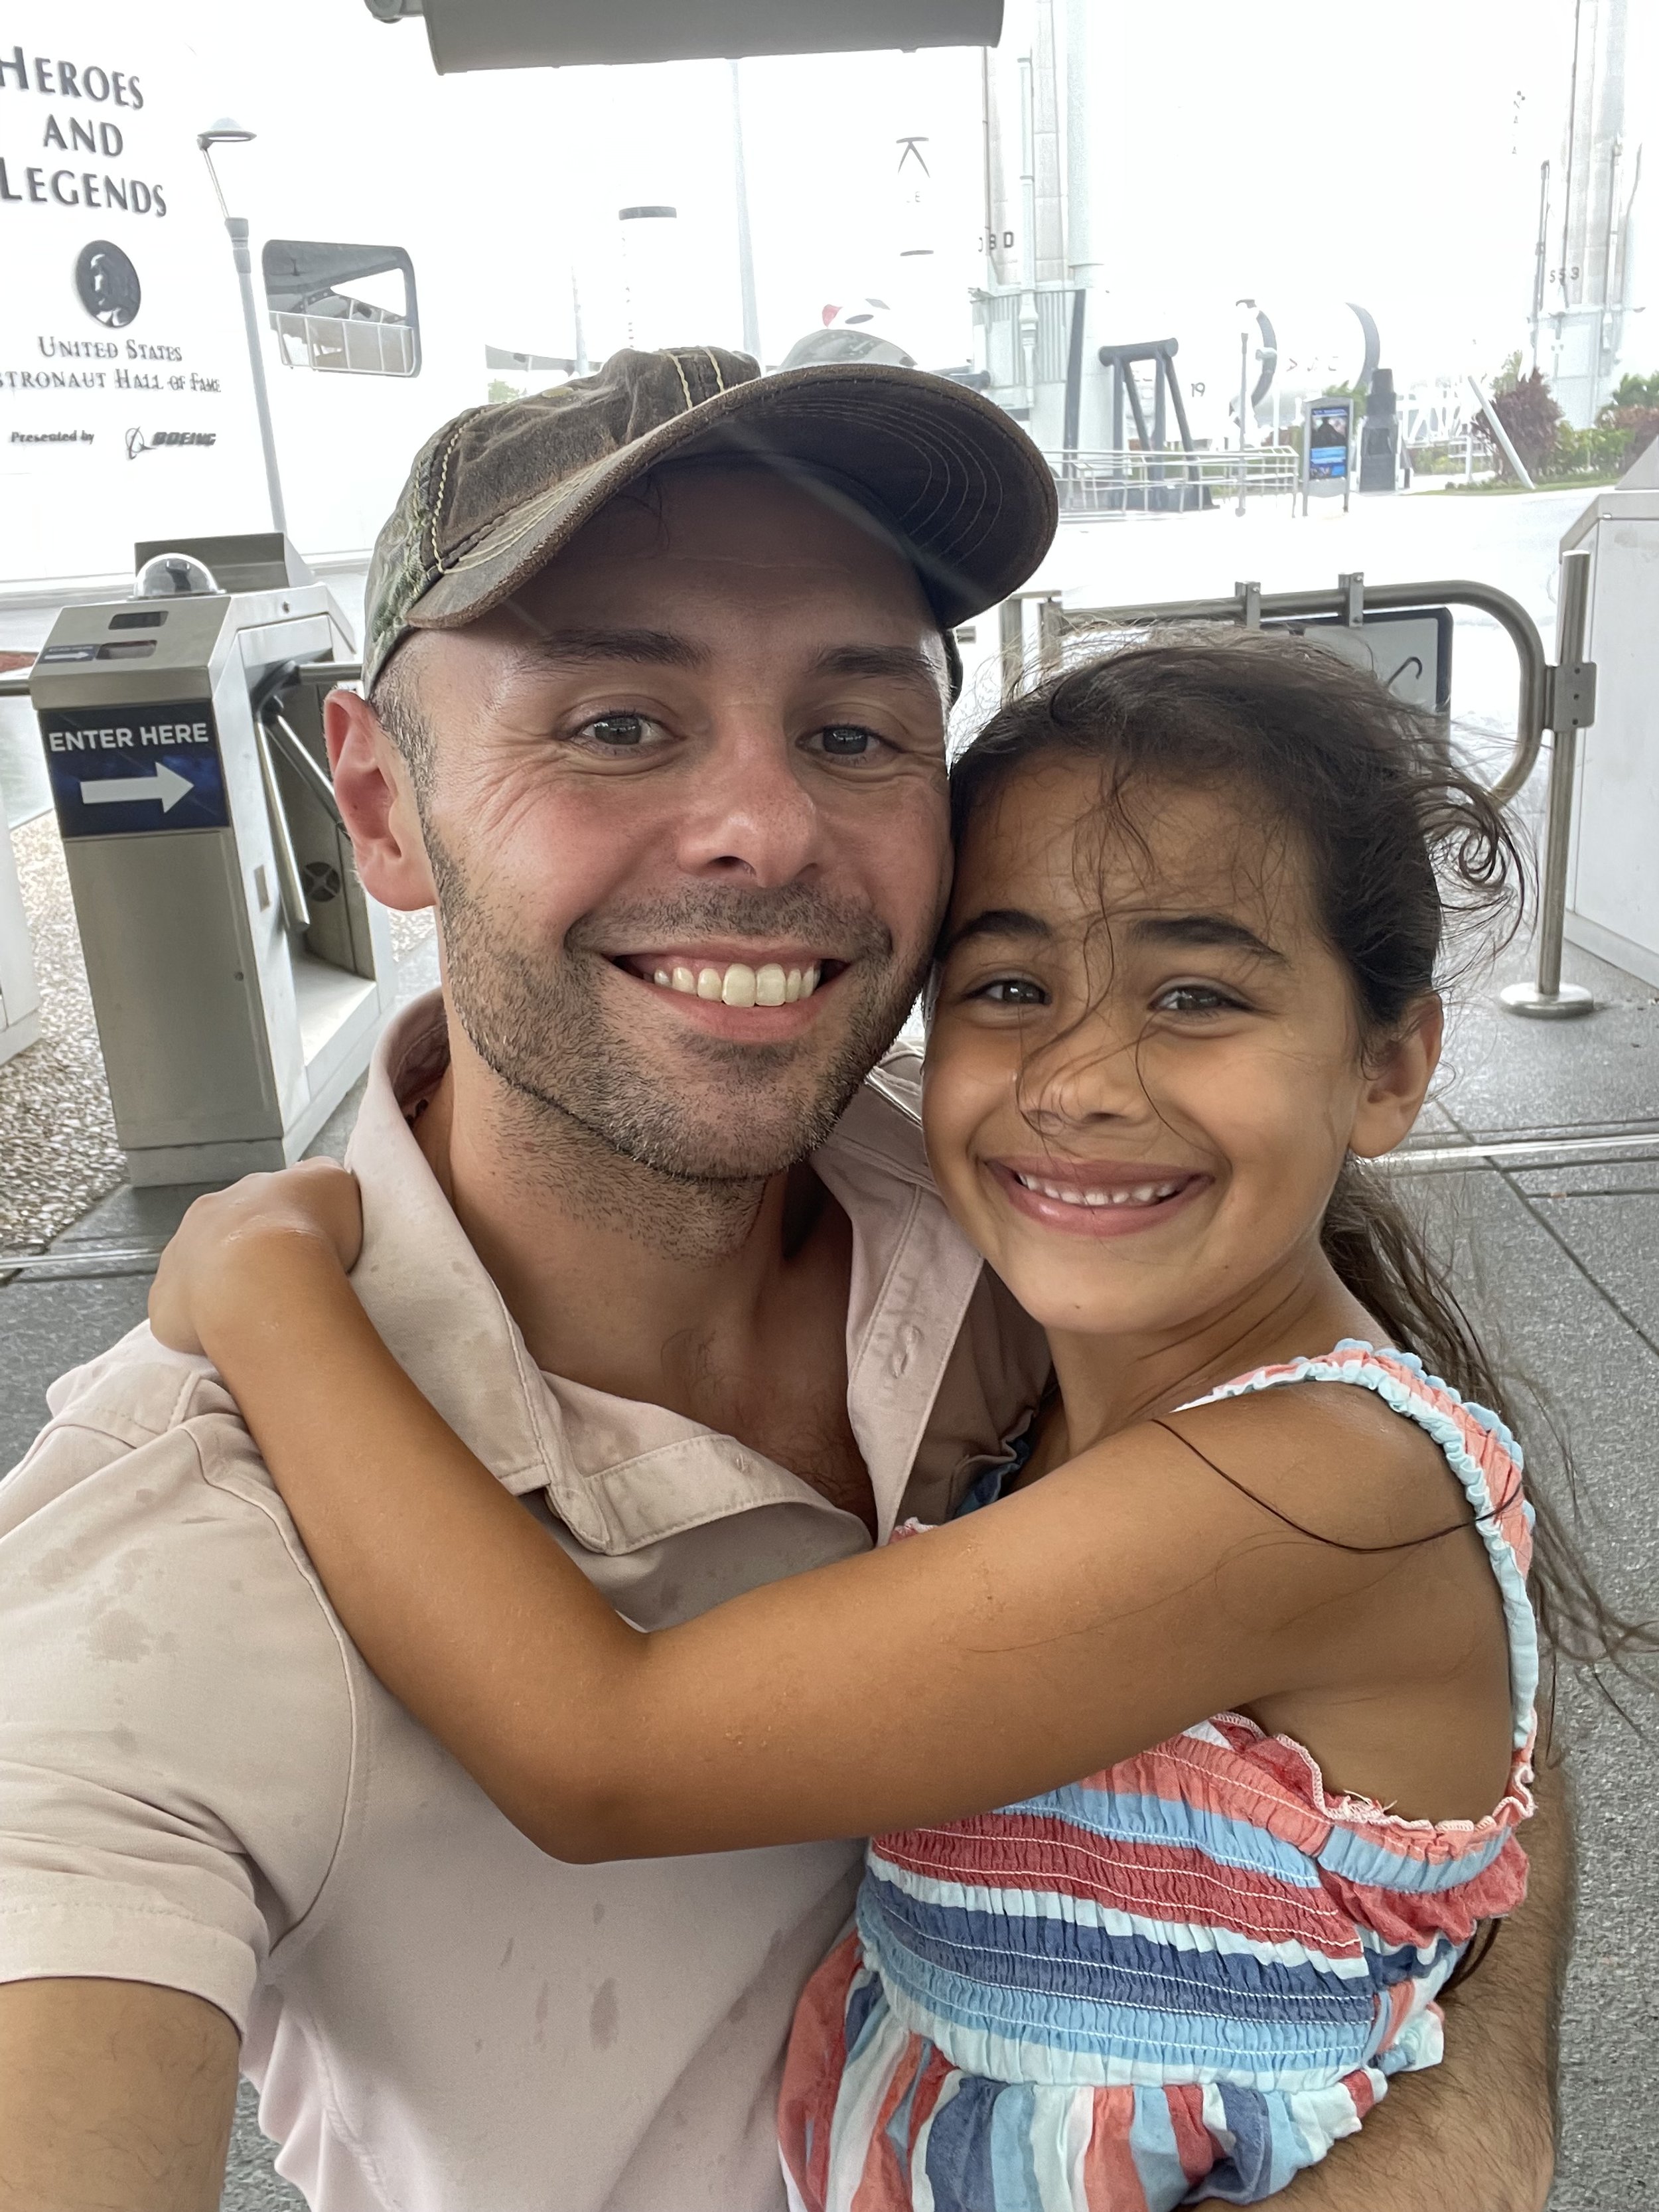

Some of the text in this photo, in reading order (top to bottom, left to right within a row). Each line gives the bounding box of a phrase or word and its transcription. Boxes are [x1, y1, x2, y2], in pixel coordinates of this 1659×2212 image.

[0, 46, 144, 110] HEROES
[43, 113, 123, 157] AND
[0, 156, 167, 218] LEGENDS
[38, 336, 182, 362] UNITED STATES
[115, 368, 164, 390] HALL
[167, 375, 186, 391] OF
[190, 372, 222, 393] FAME
[11, 429, 94, 445] Presented by
[151, 431, 216, 447] BOEING
[49, 723, 209, 752] ENTER HERE
